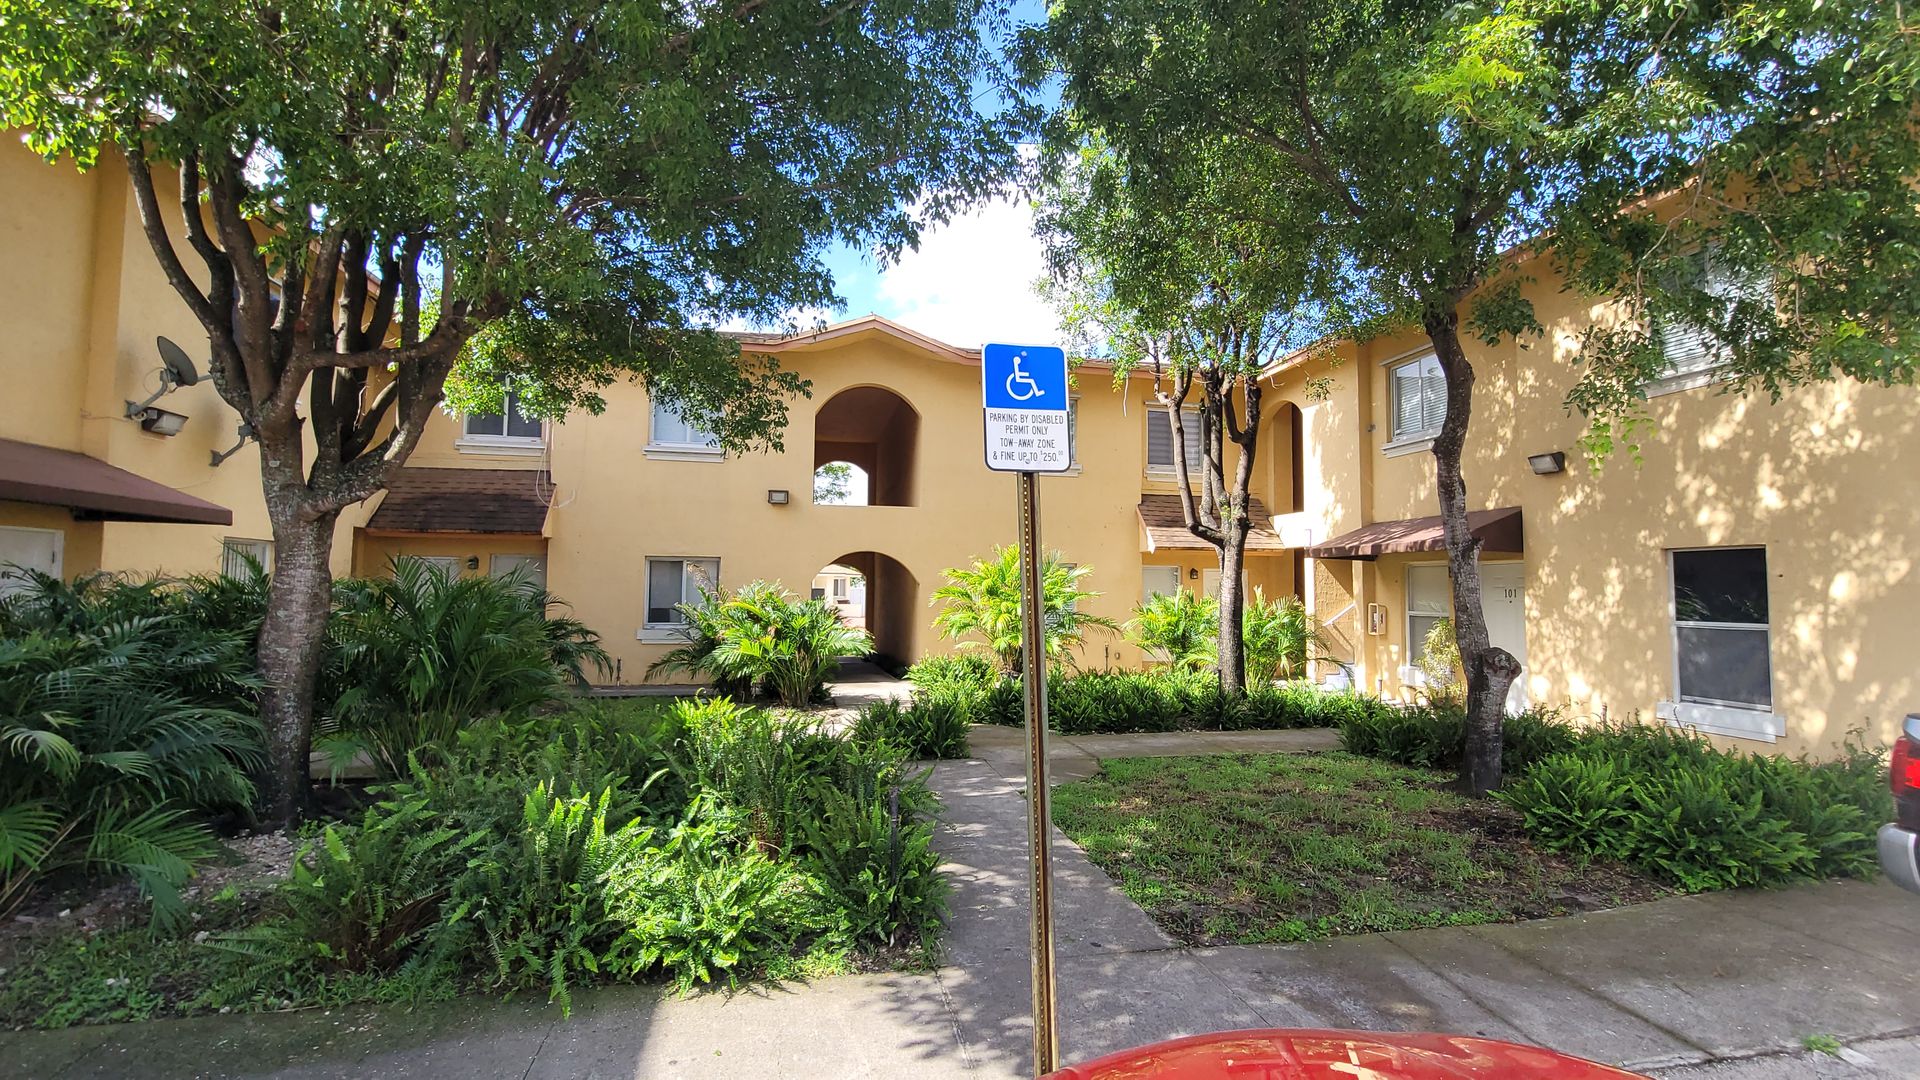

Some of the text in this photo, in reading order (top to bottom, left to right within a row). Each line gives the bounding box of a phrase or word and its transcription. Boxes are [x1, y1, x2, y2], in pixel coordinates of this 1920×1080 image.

[989, 412, 1064, 424] PARKING BY DISABLED
[1005, 425, 1049, 435] PERMIT ONLY
[1000, 437, 1056, 449] TOW-AWAY ZONE
[992, 450, 998, 460] &
[1001, 451, 1015, 461] FINE
[1018, 452, 1027, 461] UP
[1030, 452, 1038, 462] TO
[1504, 588, 1517, 598] 101
